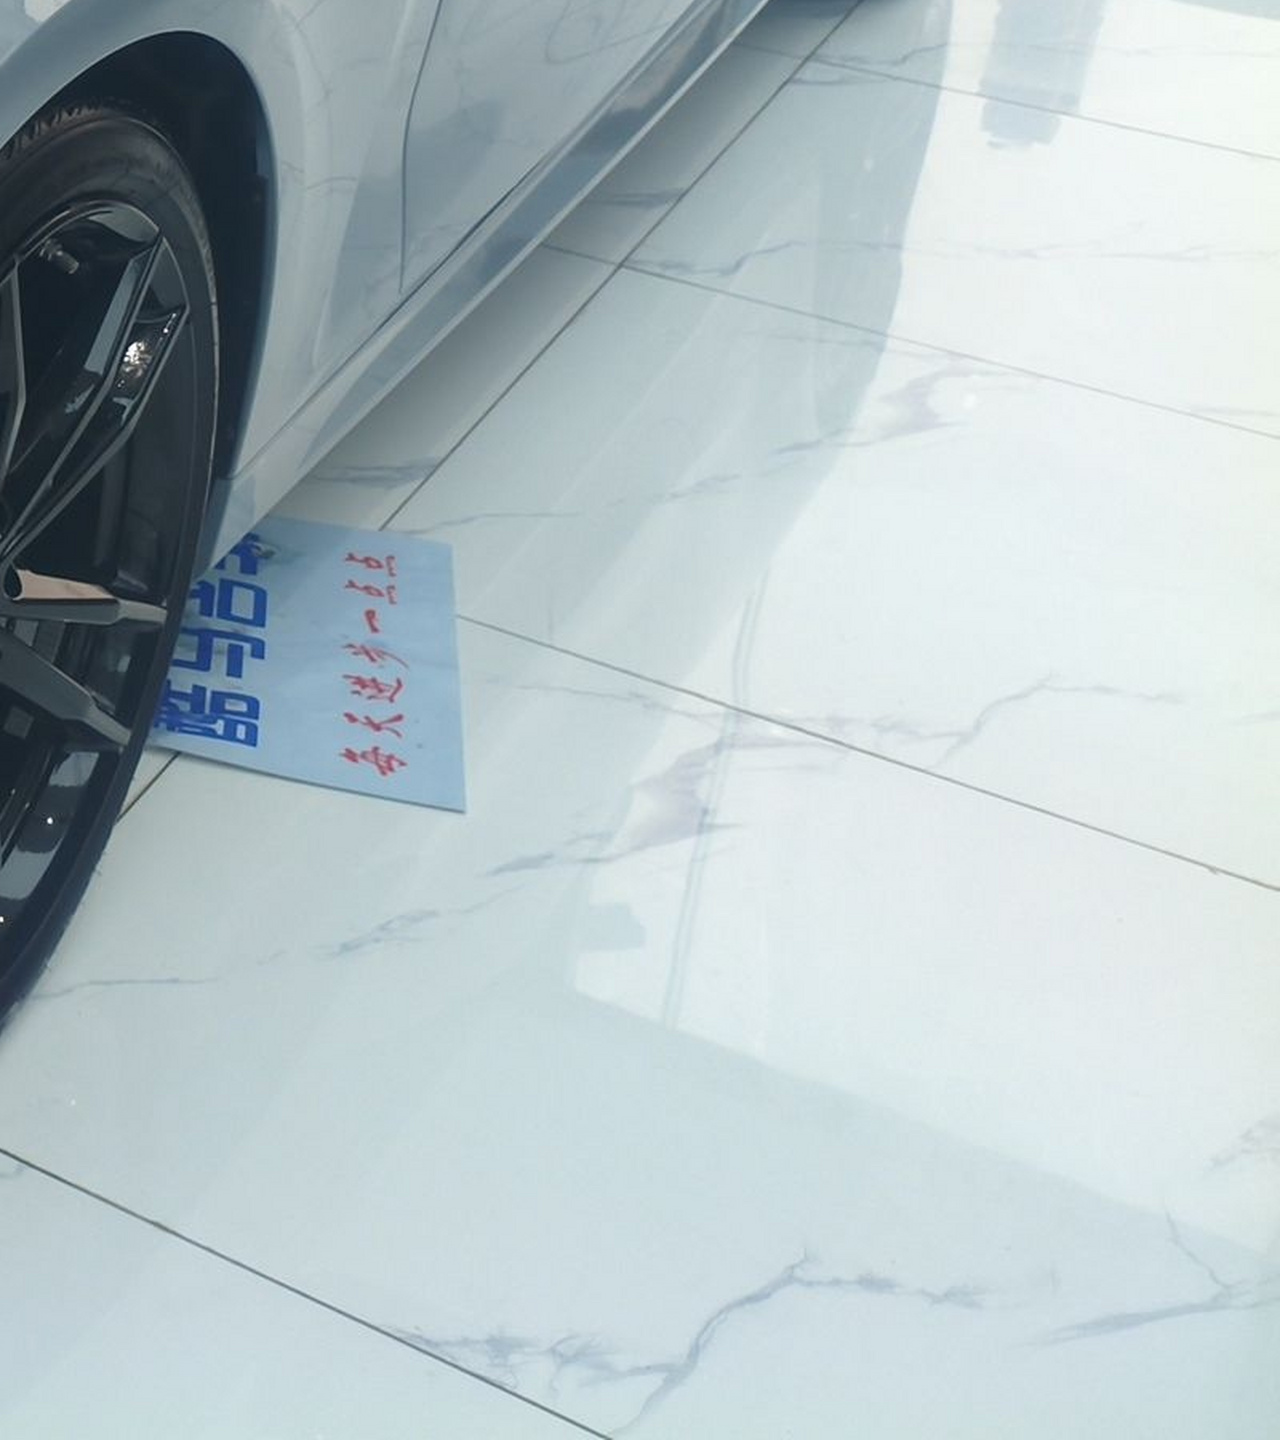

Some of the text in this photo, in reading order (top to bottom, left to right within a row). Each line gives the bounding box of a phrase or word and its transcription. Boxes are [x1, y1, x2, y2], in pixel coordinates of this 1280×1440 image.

[339, 552, 410, 778] 每天进步一点点
